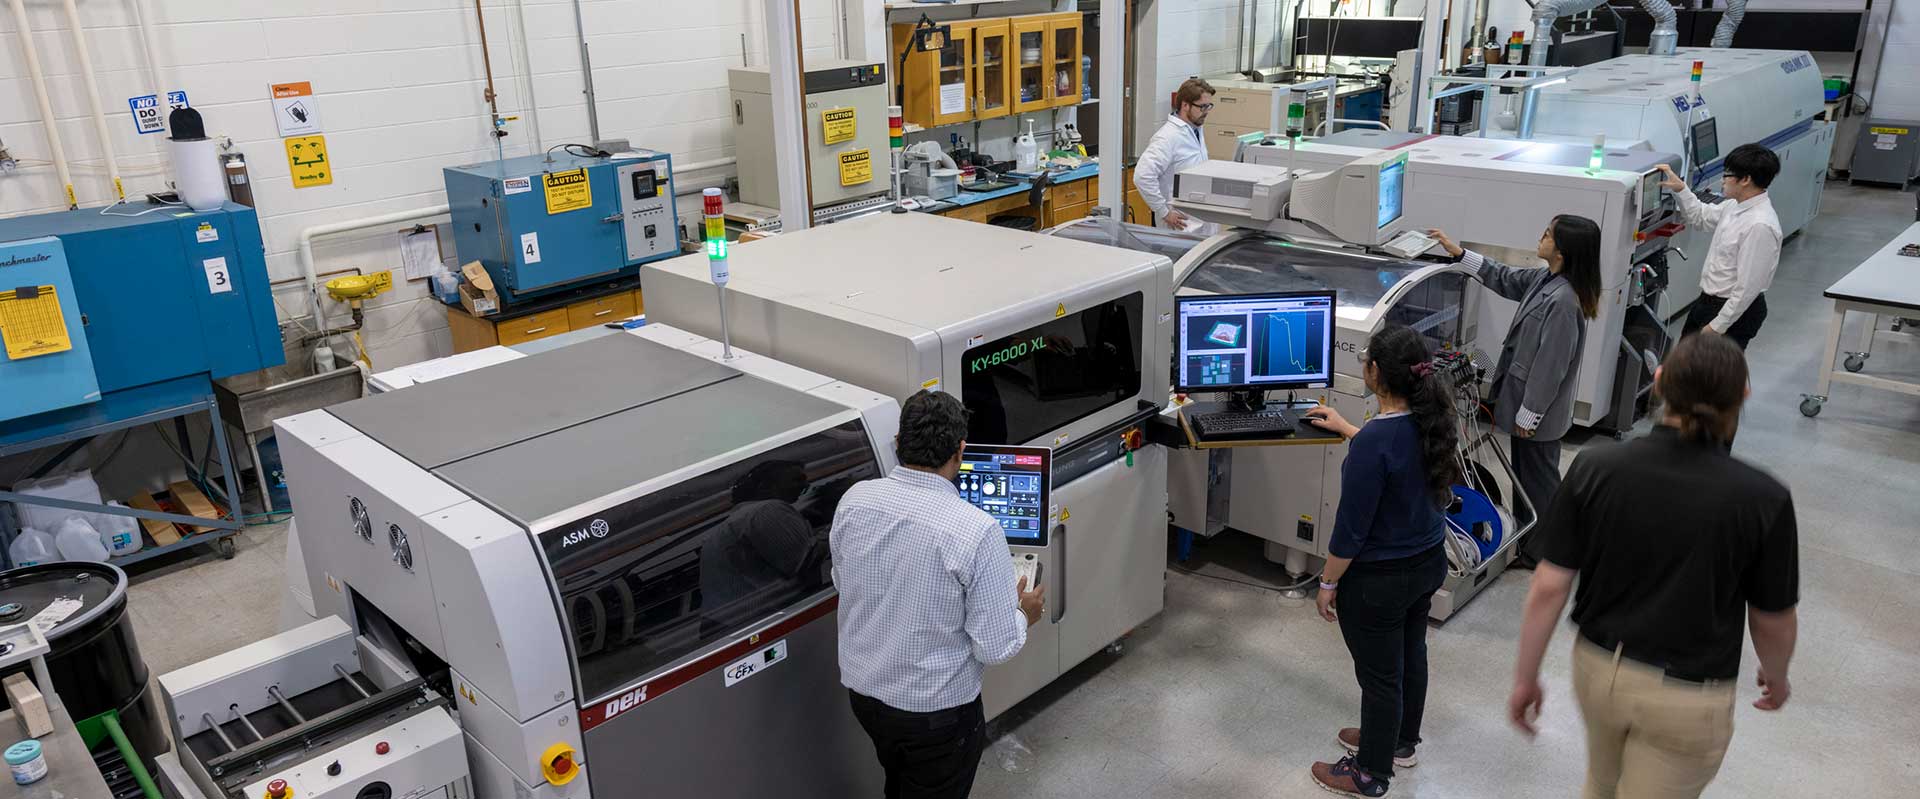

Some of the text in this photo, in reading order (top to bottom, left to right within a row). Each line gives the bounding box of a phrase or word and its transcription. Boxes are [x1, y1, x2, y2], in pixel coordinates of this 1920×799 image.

[139, 109, 157, 118] DO
[826, 111, 853, 120] CAUTION
[843, 153, 868, 162] CAUTION
[548, 174, 585, 186] CAUTION
[525, 243, 535, 256] 4
[0, 253, 51, 268] nchmaster
[214, 271, 226, 286] 3
[1334, 340, 1356, 353] ACE
[971, 335, 1047, 374] KY-6000 XL
[562, 528, 591, 548] ASM
[735, 663, 754, 680] CFX
